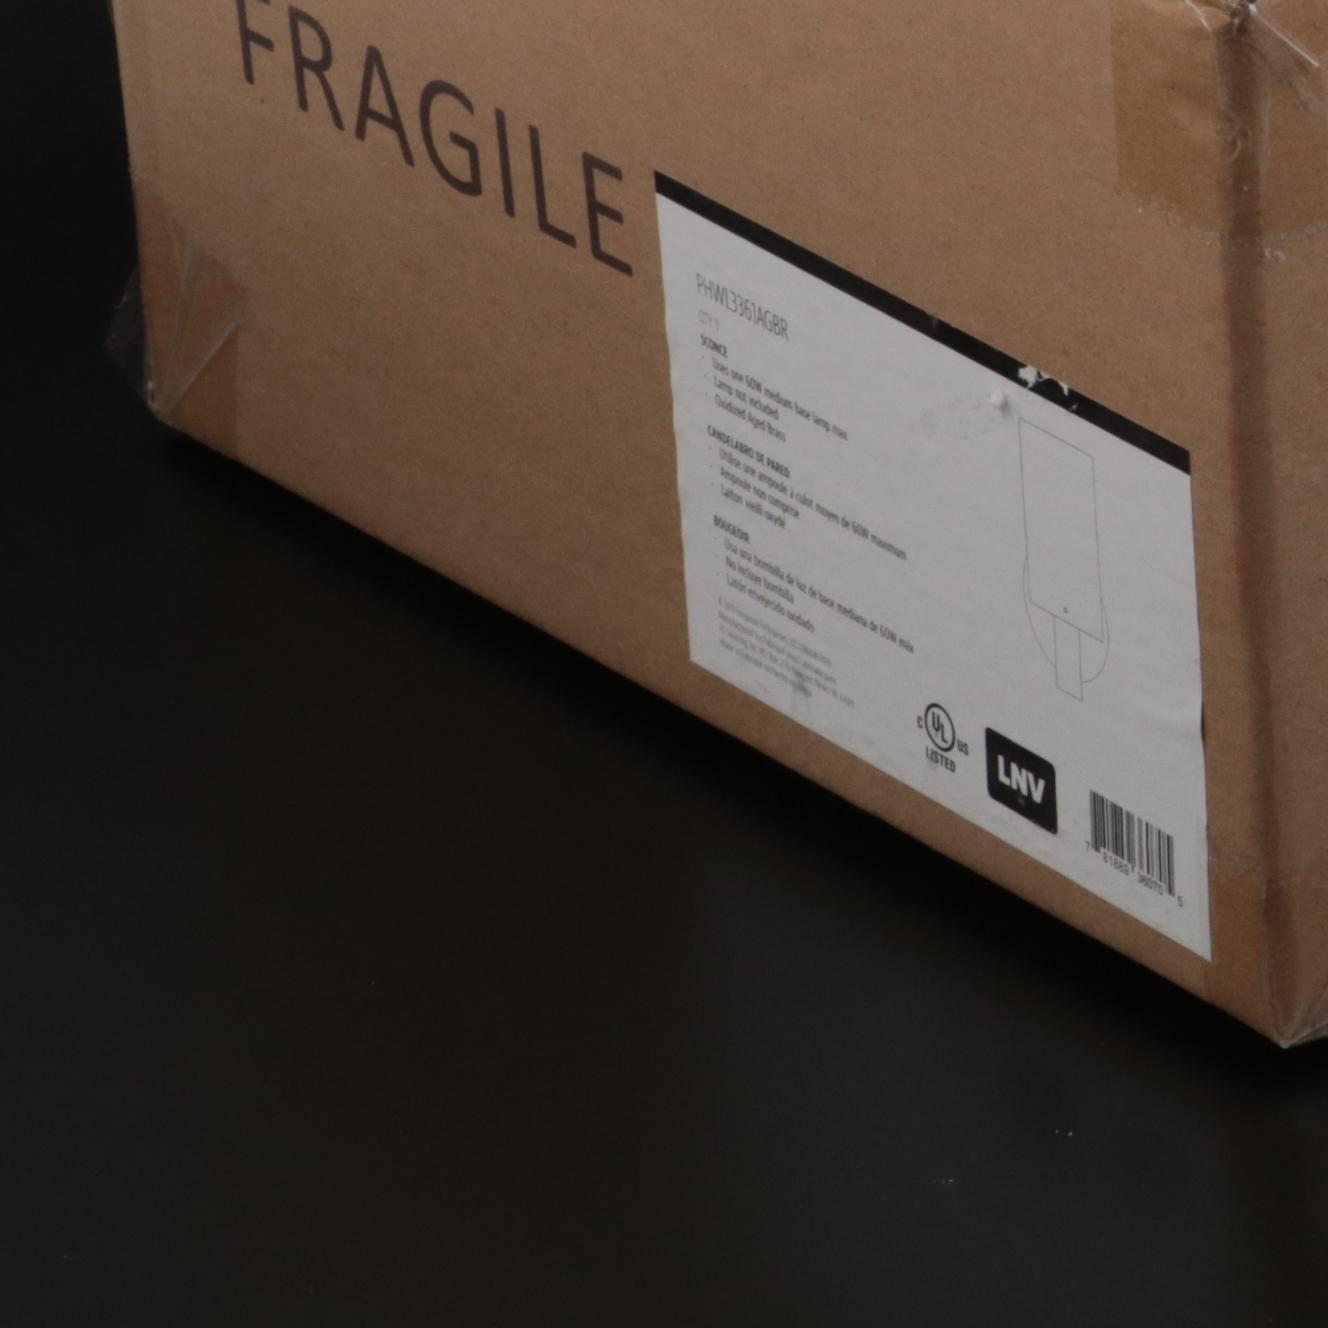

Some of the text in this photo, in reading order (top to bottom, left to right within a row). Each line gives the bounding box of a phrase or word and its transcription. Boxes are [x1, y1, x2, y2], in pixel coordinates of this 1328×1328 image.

[931, 711, 948, 744] UL
[956, 739, 969, 756] US
[925, 747, 956, 773] LISTED
[997, 755, 1045, 803] LNV
